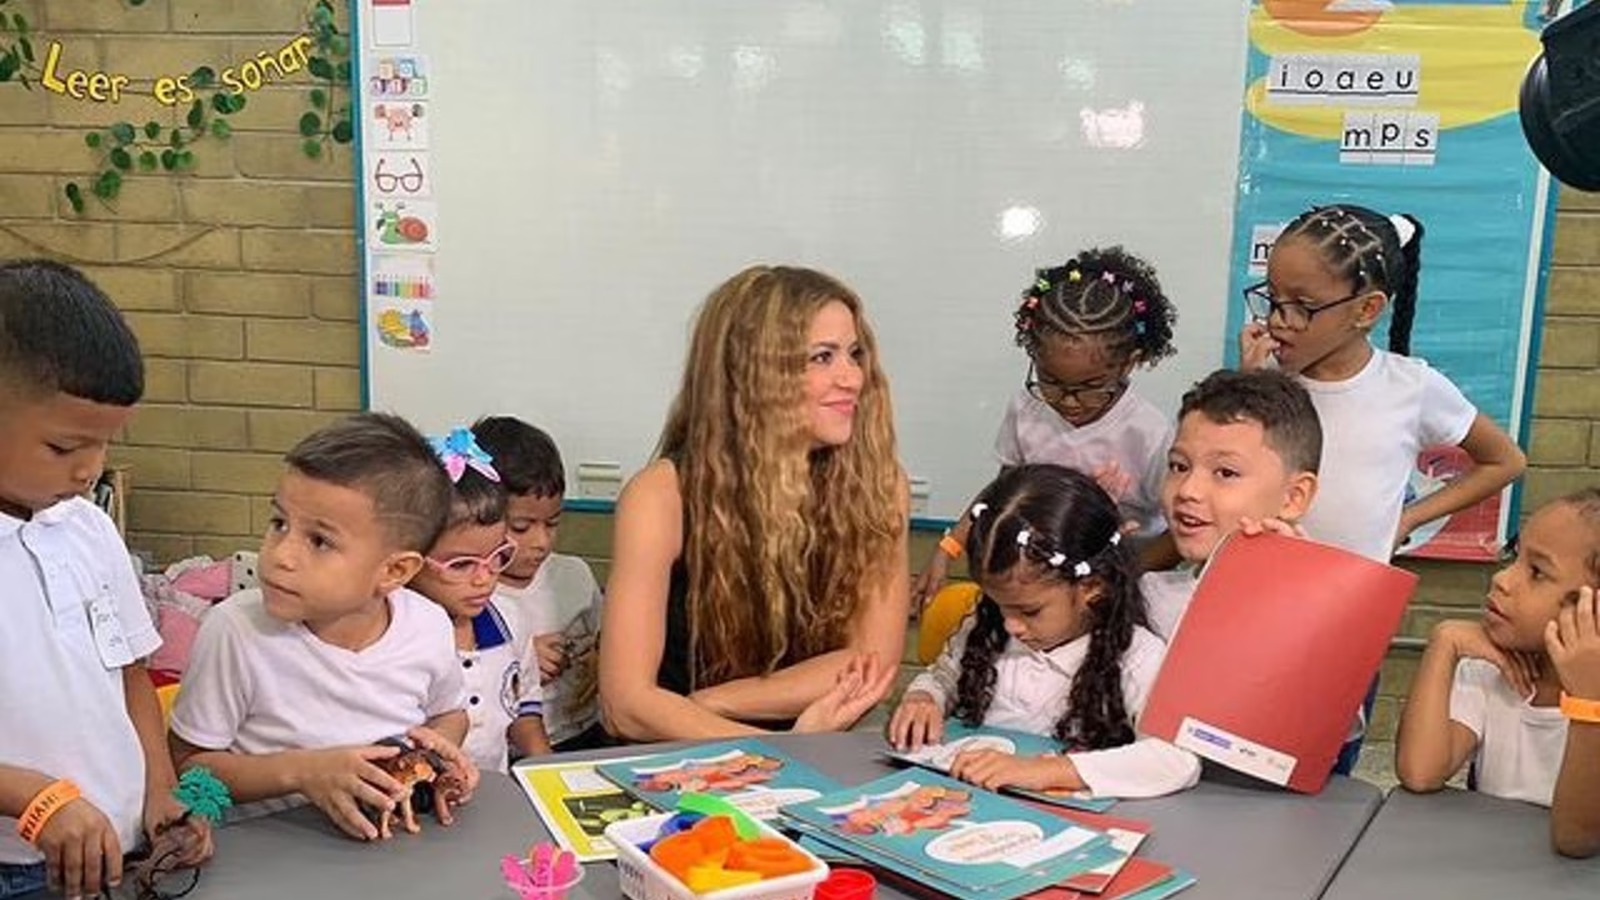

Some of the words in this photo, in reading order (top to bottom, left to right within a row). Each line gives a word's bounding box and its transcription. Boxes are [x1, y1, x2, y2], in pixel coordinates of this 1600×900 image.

[41, 42, 129, 102] Leer
[154, 76, 194, 105] es
[222, 34, 312, 95] soñar
